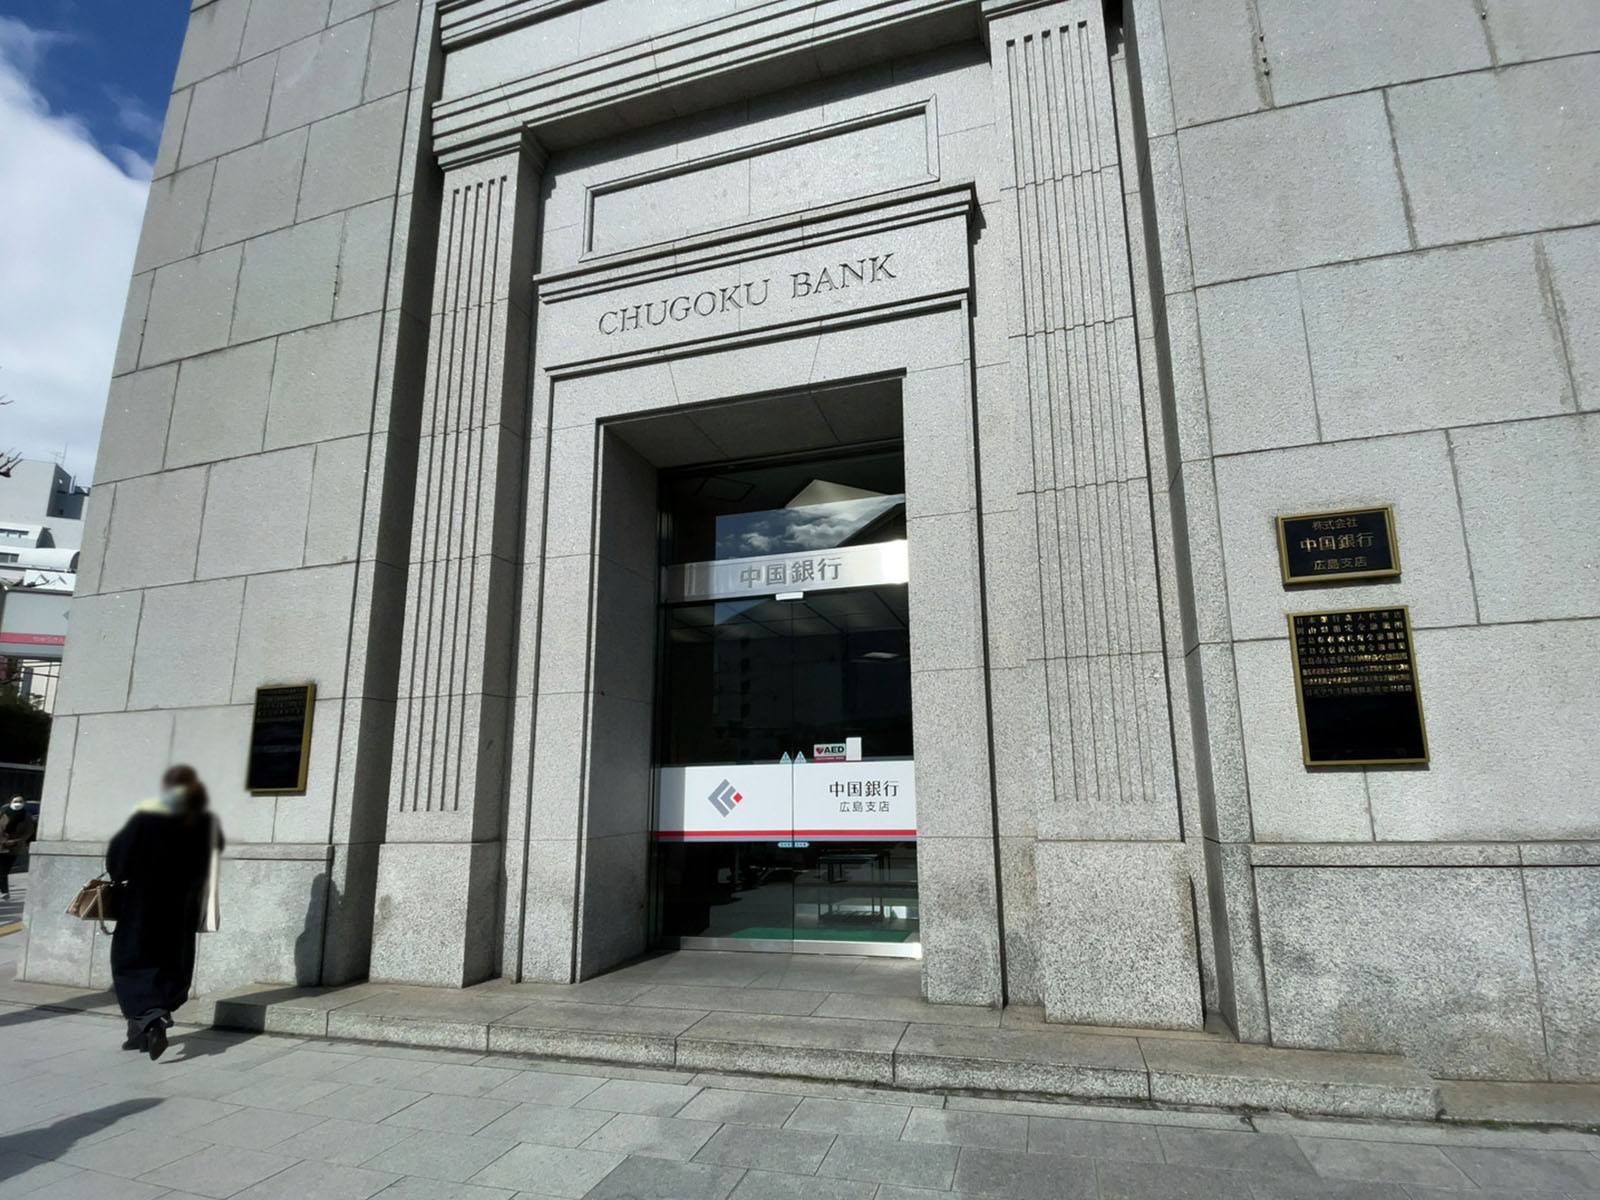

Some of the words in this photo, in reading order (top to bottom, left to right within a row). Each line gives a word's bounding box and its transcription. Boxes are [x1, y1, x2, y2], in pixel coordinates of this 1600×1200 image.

[599, 279, 770, 335] CHUGOKU
[790, 253, 896, 298] BANK
[1300, 532, 1374, 553] 中国銀行
[740, 557, 843, 588] 中国銀行
[1313, 556, 1368, 571] 広島支店
[824, 745, 845, 754] AED
[829, 780, 899, 798] 中国銀行
[839, 800, 890, 813] 広島支店
